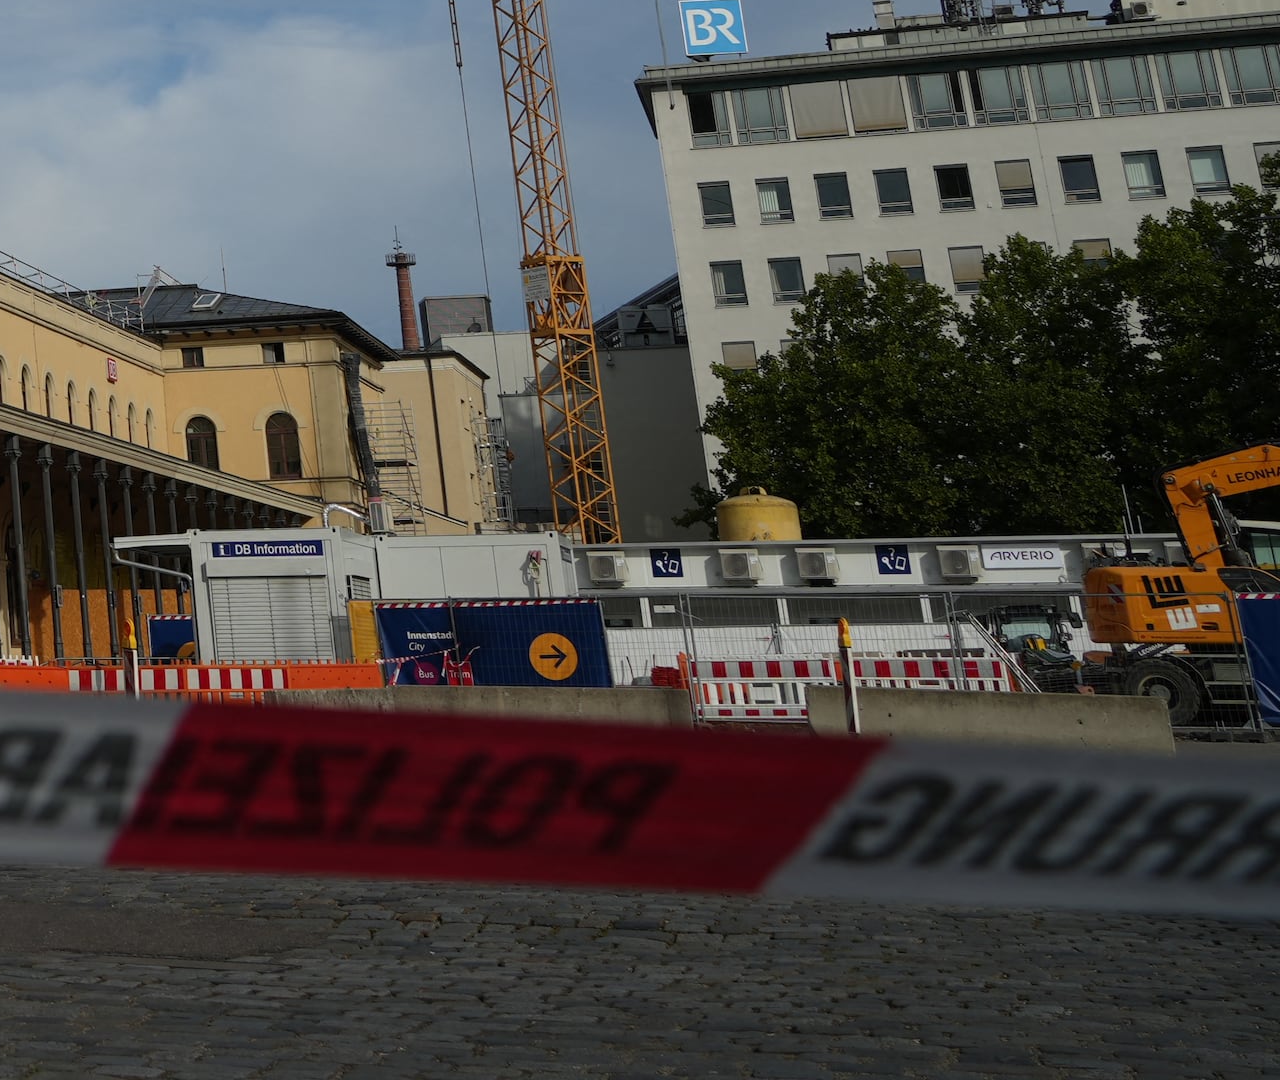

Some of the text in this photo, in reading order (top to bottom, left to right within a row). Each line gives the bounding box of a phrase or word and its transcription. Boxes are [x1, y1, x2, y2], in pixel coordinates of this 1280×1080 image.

[685, 7, 741, 46] BR
[235, 544, 251, 555] DB
[254, 543, 317, 555] Information
[990, 550, 1054, 561] ARVERIO
[409, 642, 425, 652] City
[418, 671, 434, 679] Bus
